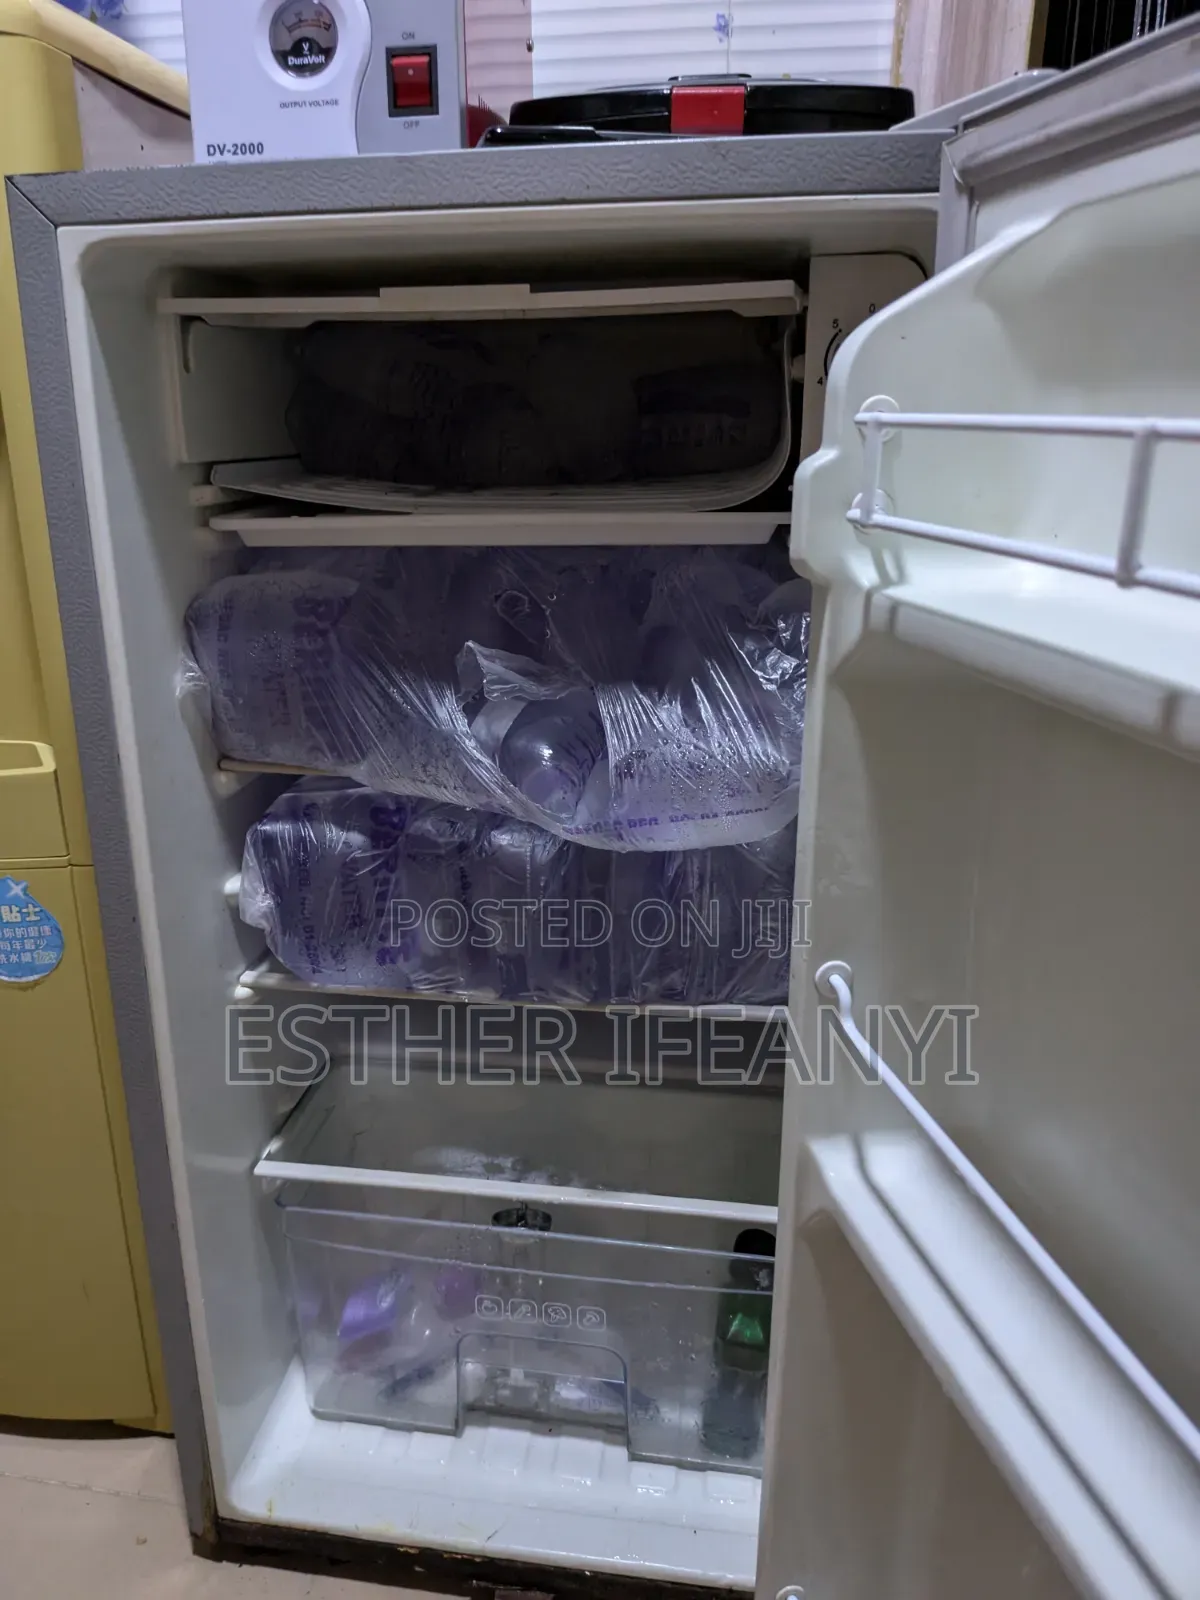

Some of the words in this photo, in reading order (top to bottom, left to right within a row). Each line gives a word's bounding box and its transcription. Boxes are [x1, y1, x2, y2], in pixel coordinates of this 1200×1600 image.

[401, 31, 415, 41] ON
[288, 54, 326, 67] DuraVolt
[279, 100, 308, 110] OUTPUT
[308, 99, 340, 109] VOLTAGE
[403, 120, 420, 130] OFF
[206, 142, 265, 157] DV-2000
[832, 318, 839, 329] 5
[816, 376, 824, 387] 4
